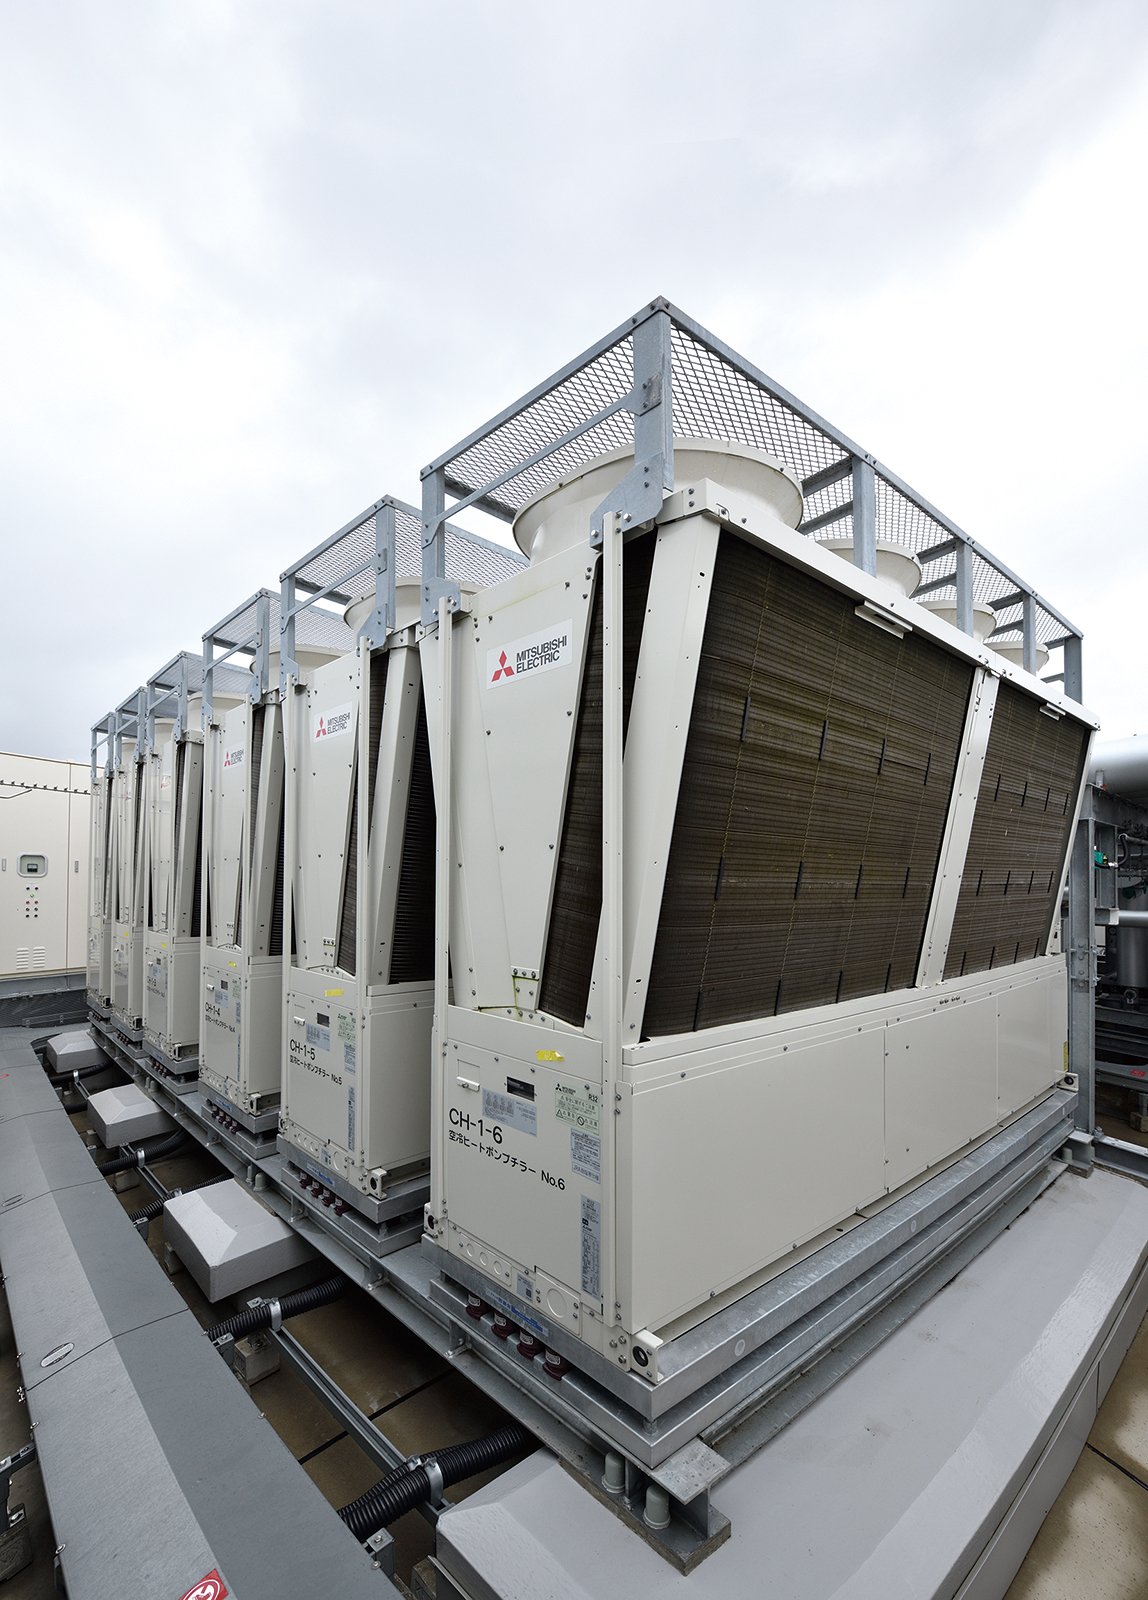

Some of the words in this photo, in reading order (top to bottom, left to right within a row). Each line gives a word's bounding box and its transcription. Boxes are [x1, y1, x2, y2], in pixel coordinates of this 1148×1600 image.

[516, 635, 567, 663] MITSUBISHI
[516, 649, 560, 674] ELECTRIC
[327, 712, 351, 727] MITSUBISHI
[327, 721, 348, 735] ELECTRIC
[290, 1039, 315, 1060] CH-1-5
[331, 1074, 342, 1085] No.5
[449, 1107, 503, 1145] CH-1-6
[448, 1129, 537, 1173] 空冷ヒートポンプチラー
[541, 1169, 567, 1191] No.6
